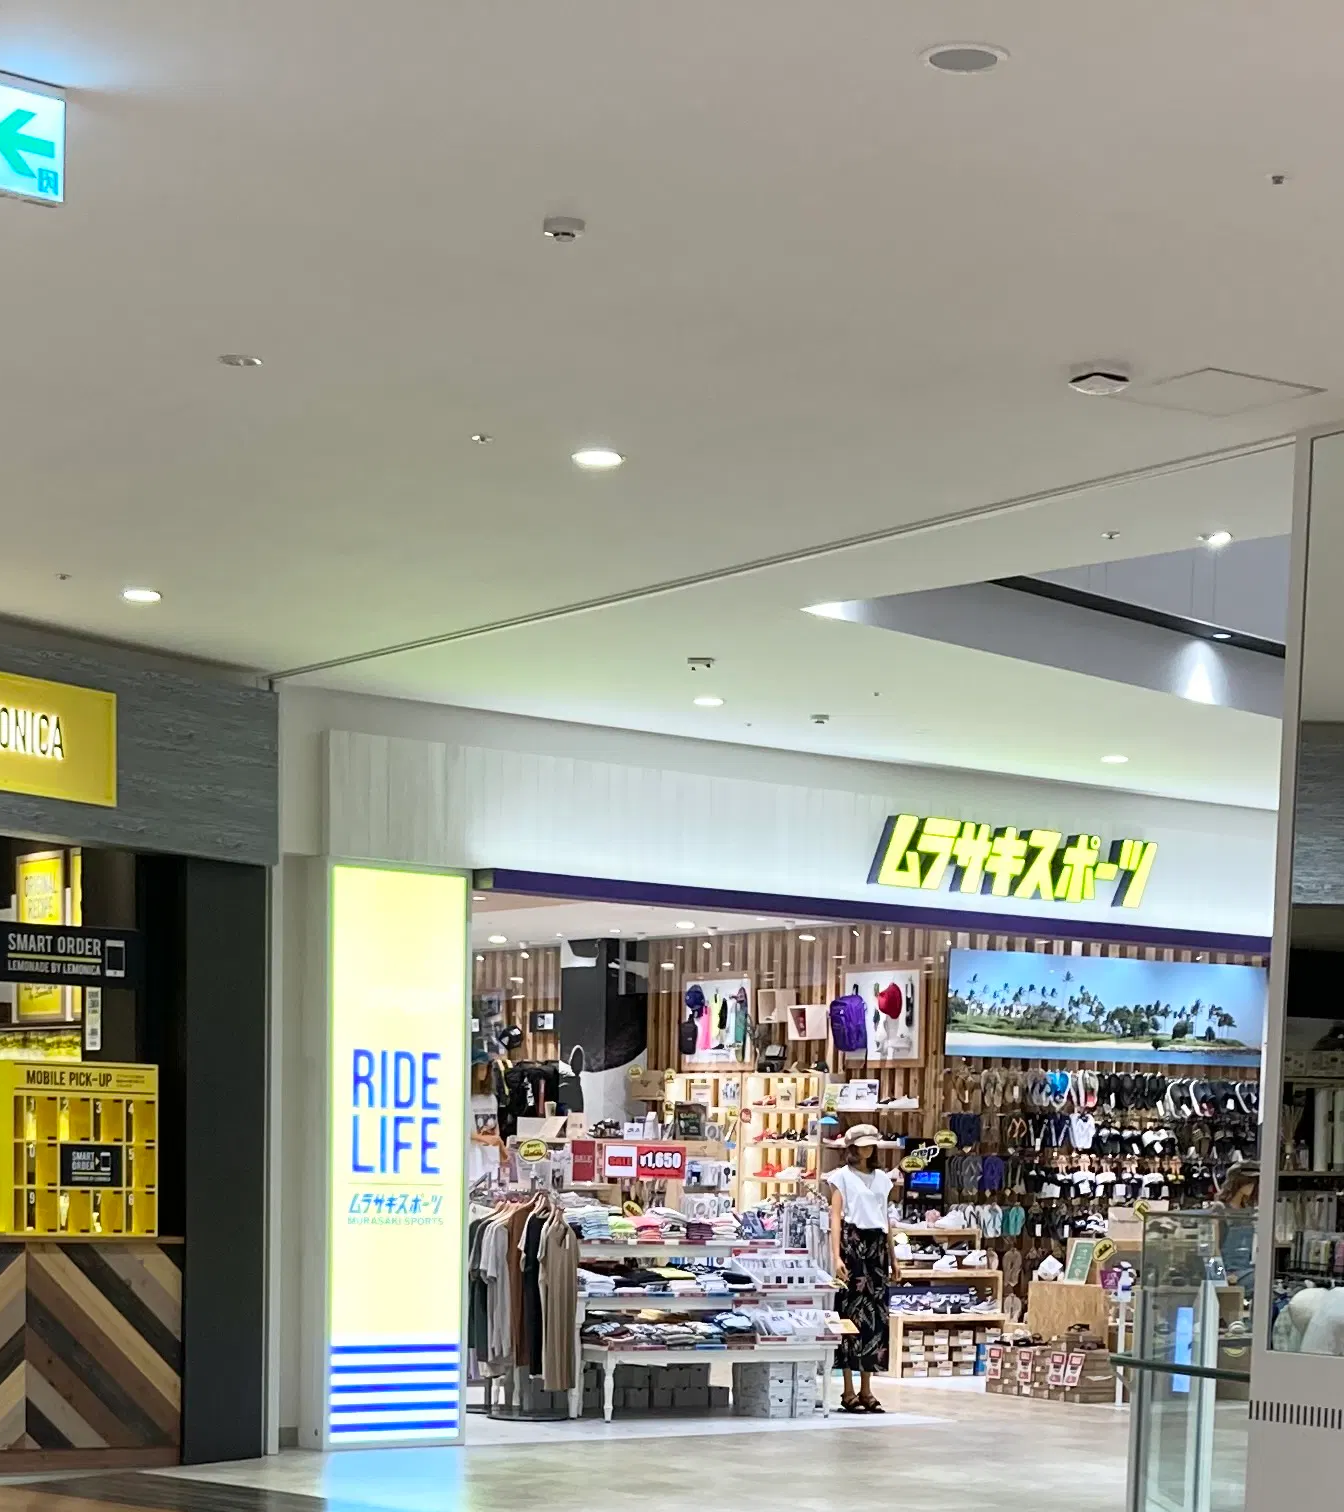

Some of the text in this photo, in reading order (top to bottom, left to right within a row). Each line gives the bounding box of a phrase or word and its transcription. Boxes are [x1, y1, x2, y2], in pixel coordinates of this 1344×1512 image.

[867, 814, 1158, 909] ムラサキスポーツ
[7, 932, 102, 956] SMART ORDER
[7, 959, 102, 976] LEMONADE BY LEMONICA
[26, 1069, 66, 1086] MOBILE
[68, 1071, 113, 1088] PICK-UP
[352, 1048, 442, 1111] RIDE
[352, 1114, 441, 1175] LIFE
[71, 1151, 96, 1161] SMART
[607, 1151, 682, 1170] SALE ¥1,650
[71, 1161, 96, 1171] ORDER
[348, 1192, 444, 1215] ムラサキスポーツ
[347, 1216, 444, 1226] MURASAKI SPORTS
